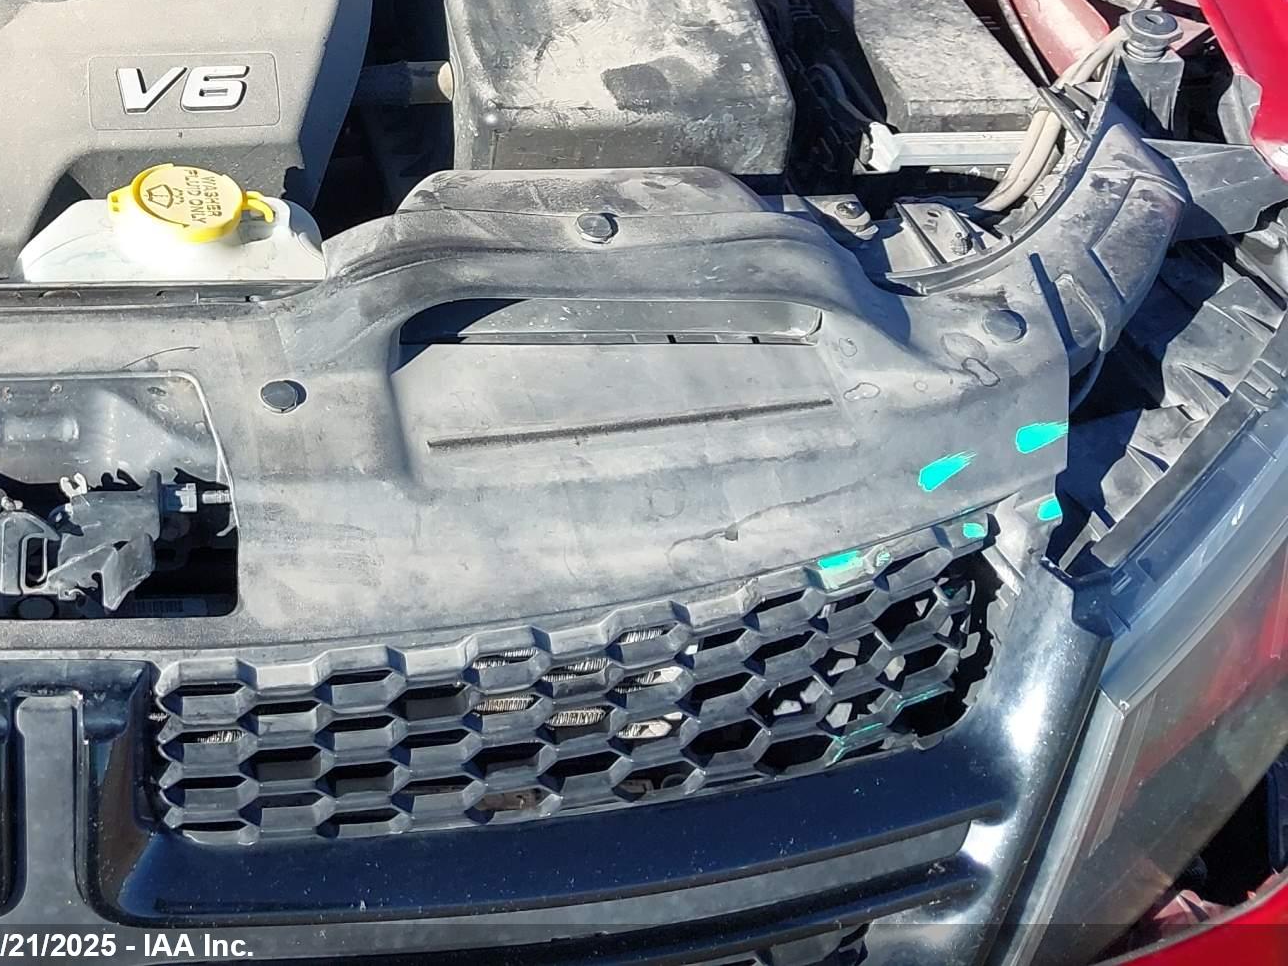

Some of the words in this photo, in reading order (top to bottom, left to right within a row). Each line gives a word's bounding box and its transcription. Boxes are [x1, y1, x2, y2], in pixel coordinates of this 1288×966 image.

[116, 66, 250, 113] V6
[184, 169, 202, 196] FLUID
[201, 177, 223, 217] WASHER
[189, 199, 207, 224] ONLY
